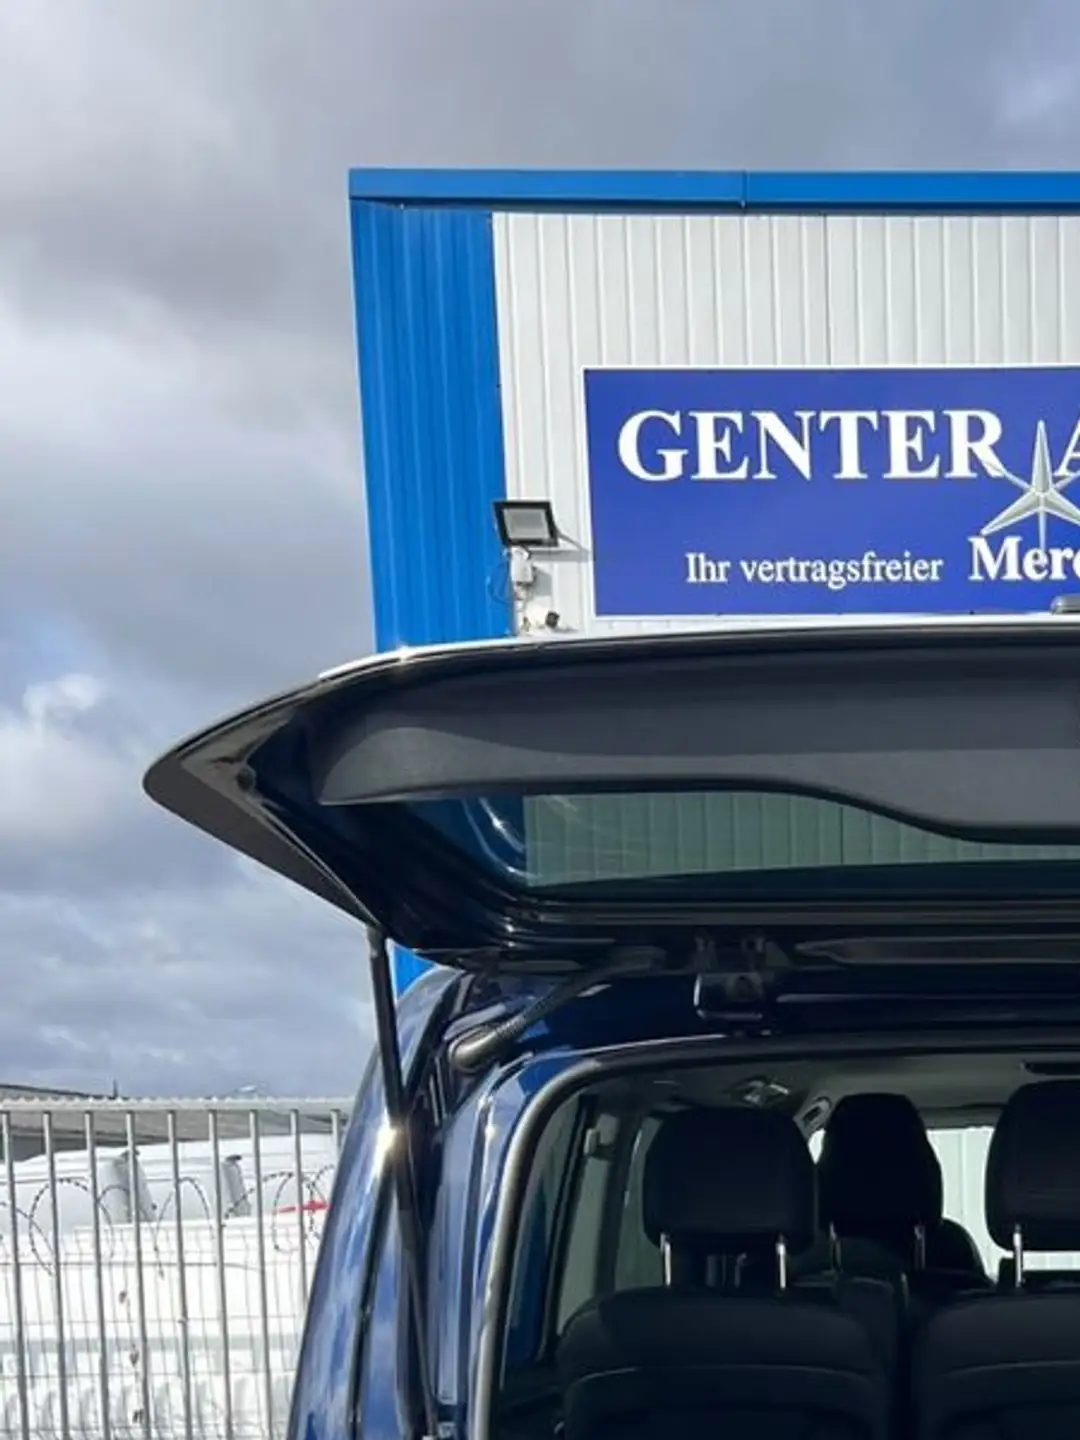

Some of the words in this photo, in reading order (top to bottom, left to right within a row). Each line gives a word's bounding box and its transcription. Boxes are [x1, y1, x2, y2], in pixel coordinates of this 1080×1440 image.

[617, 408, 1003, 481] GENTER
[686, 553, 730, 583] Ihr
[740, 551, 944, 589] vertragsfreier
